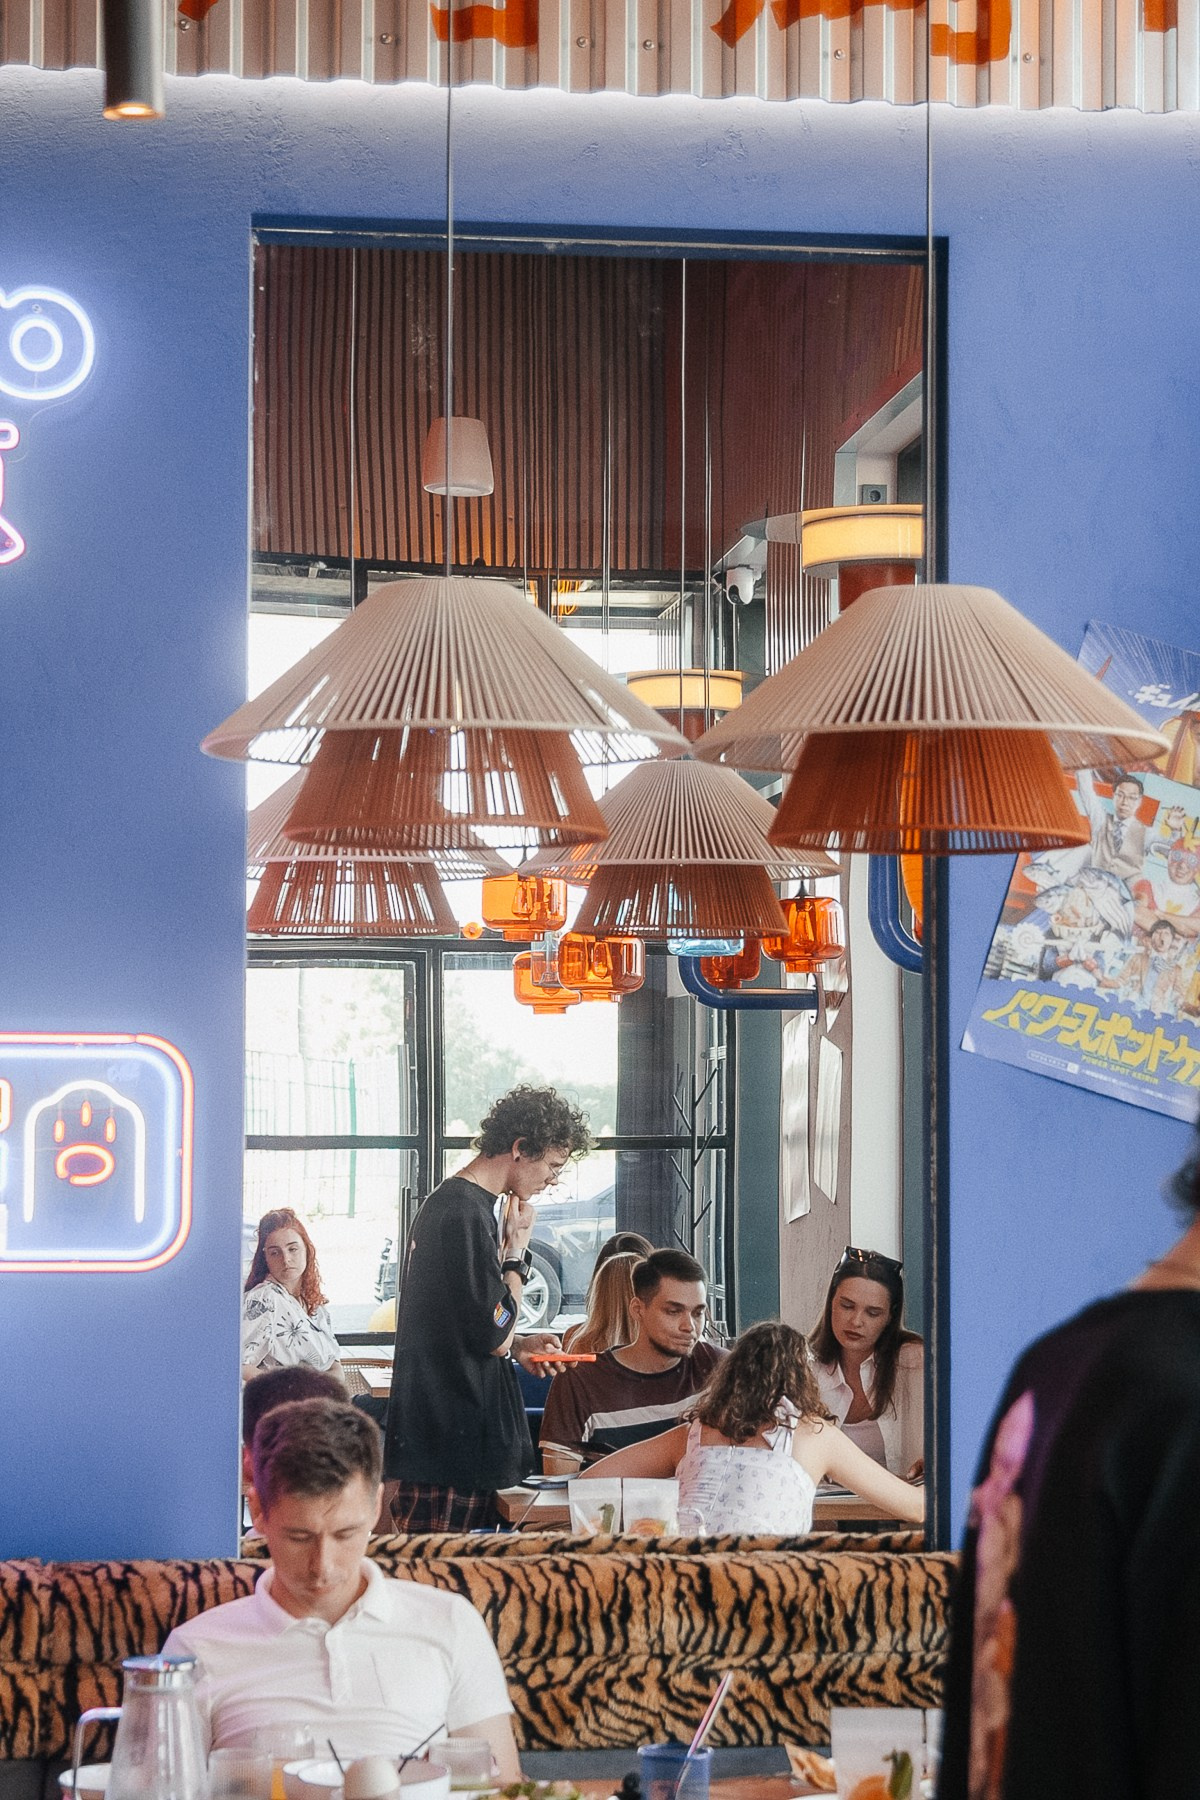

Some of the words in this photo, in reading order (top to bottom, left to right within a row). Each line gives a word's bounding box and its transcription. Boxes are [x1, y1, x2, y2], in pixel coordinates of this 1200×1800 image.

[981, 989, 1200, 1087] パワースポットケ
[1081, 1055, 1107, 1070] POWER
[1111, 1064, 1130, 1076] SPOT
